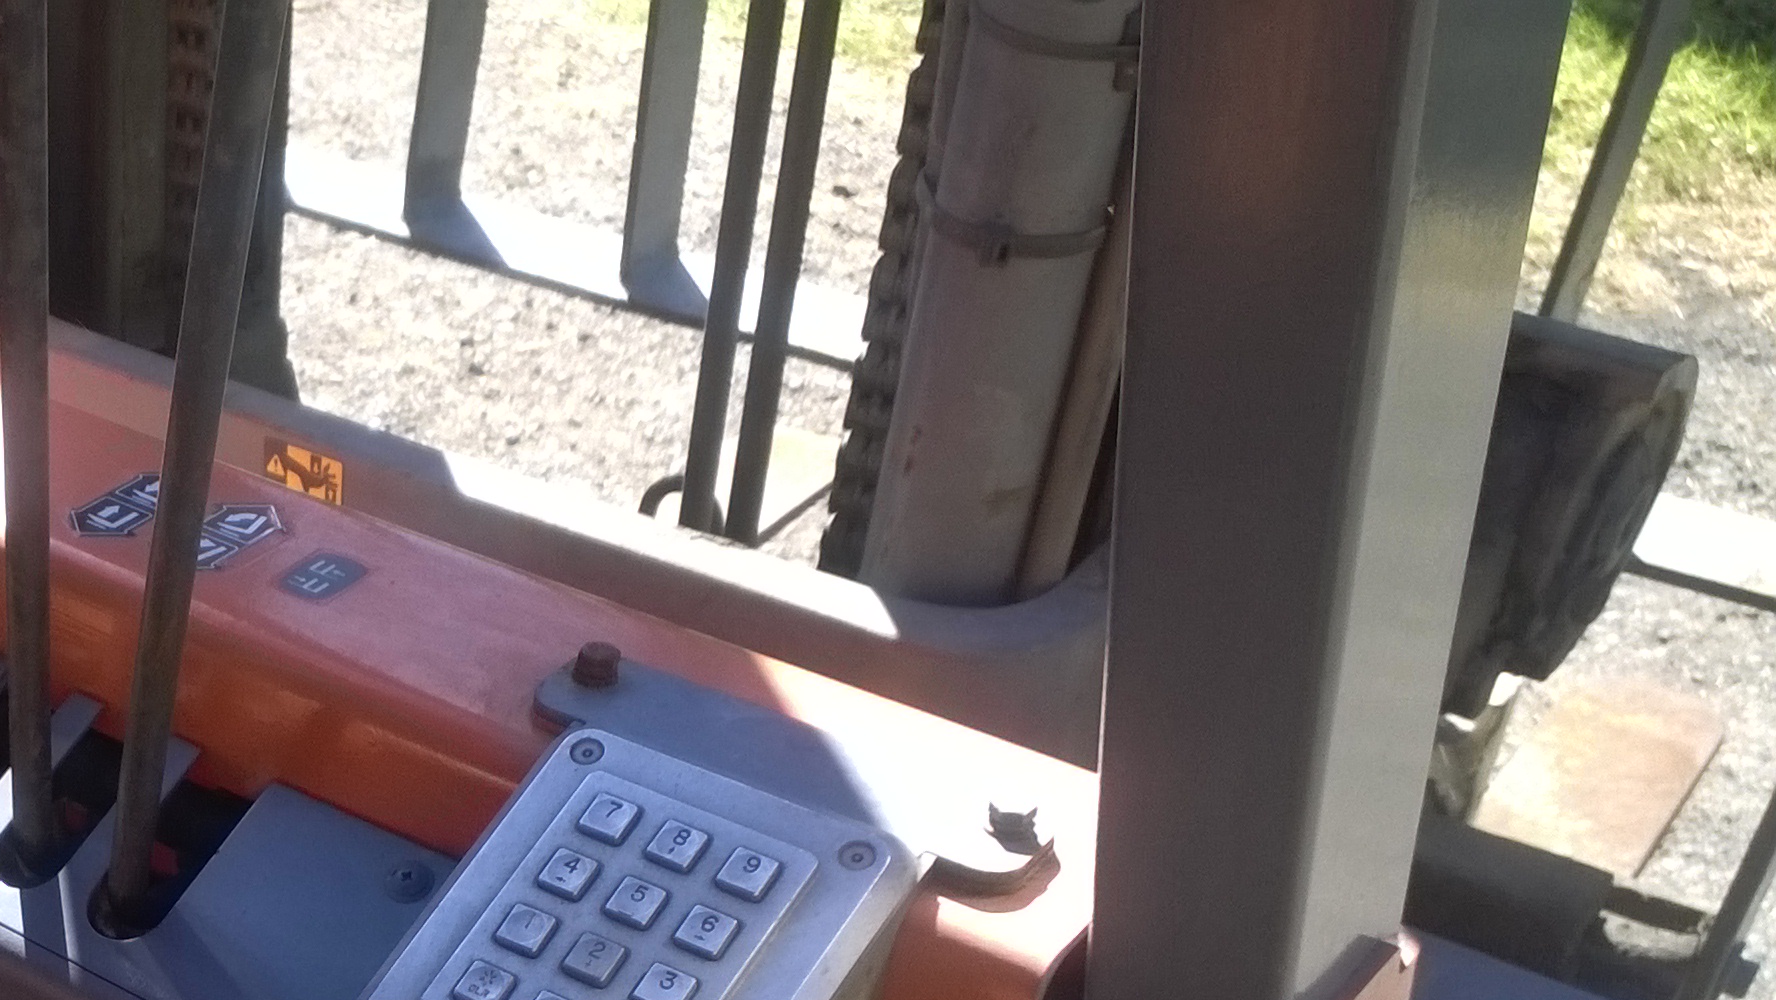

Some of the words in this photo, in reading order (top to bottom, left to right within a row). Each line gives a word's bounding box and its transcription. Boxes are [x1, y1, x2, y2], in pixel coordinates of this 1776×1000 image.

[606, 800, 623, 818] 7
[673, 828, 691, 846] 8
[563, 857, 581, 874] 4
[742, 856, 761, 873] 9
[630, 885, 648, 902] 5
[701, 915, 719, 933] 6
[588, 941, 605, 958] 2
[659, 971, 678, 990] 3
